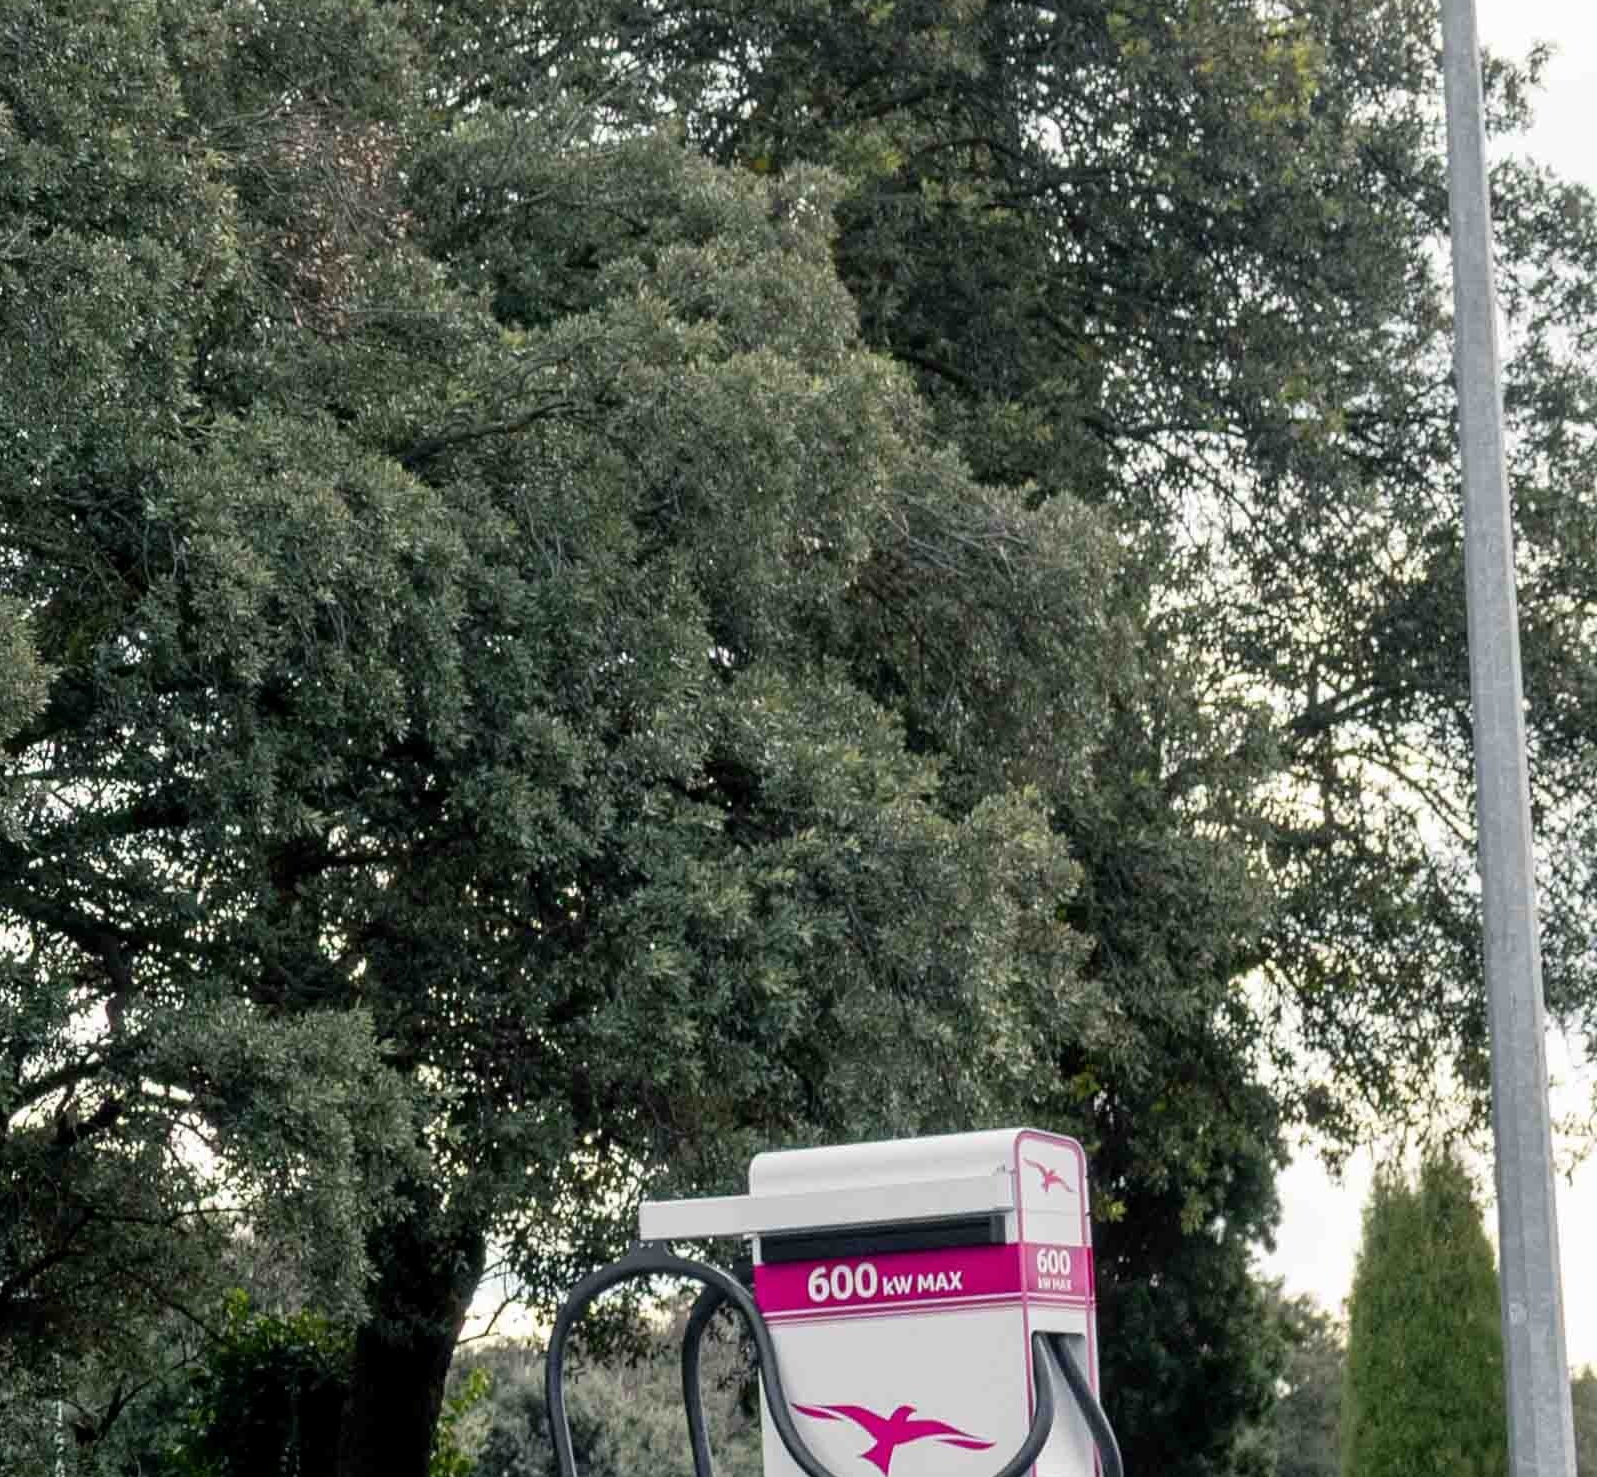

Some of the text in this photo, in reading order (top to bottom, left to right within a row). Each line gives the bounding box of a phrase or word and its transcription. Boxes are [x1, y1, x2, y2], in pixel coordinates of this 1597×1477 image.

[1037, 1248, 1071, 1275] 600
[807, 1262, 963, 1302] 600 kW MAX
